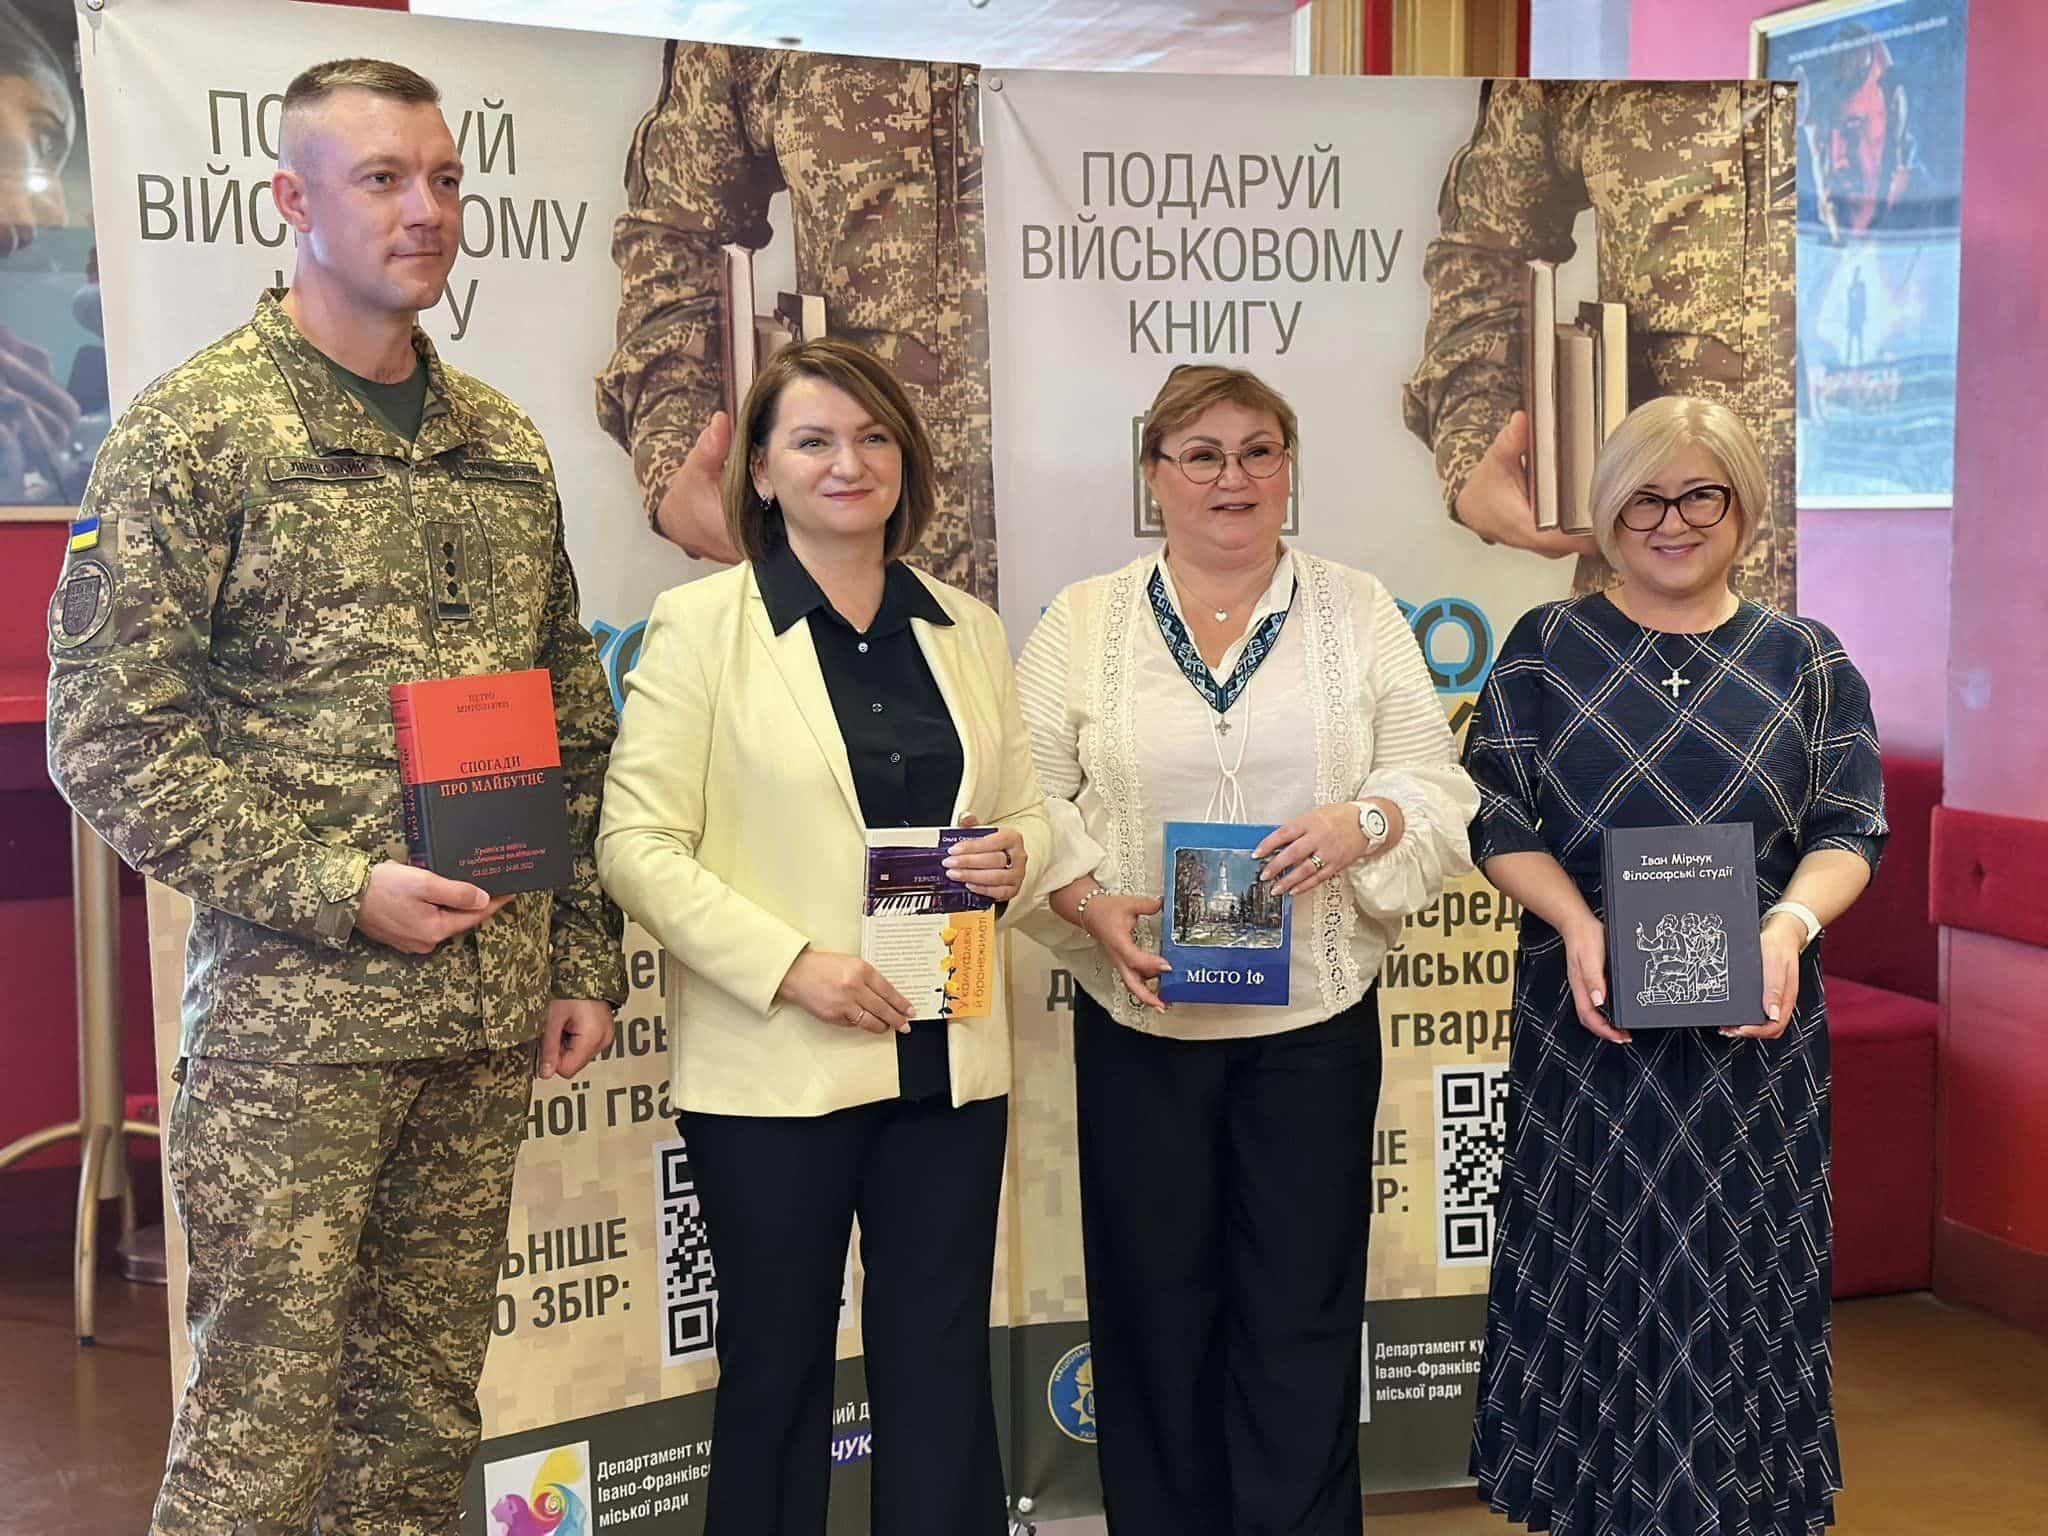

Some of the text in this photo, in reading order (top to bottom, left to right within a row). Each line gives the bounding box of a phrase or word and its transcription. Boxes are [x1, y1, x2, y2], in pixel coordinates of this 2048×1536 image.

[1080, 143, 1341, 219] ПОДАРУЙ
[1021, 213, 1403, 283] ВІЙСЬКОВОМУ
[1129, 299, 1302, 355] КНИГУ
[460, 755, 521, 774] СПОГАДИ
[440, 771, 545, 797] ПРО МАЙБУТНЄ
[1640, 853, 1713, 866] Іван Мірчук
[1622, 866, 1734, 882] Філософські студії
[1186, 968, 1265, 985] МІСТО ІФ
[532, 1273, 631, 1329] ЗБІР:
[1375, 1340, 1465, 1360] Департамент
[1375, 1360, 1481, 1380] Івано-Франківс
[1376, 1382, 1462, 1401] міської ради
[597, 1443, 693, 1482] Департамент
[599, 1492, 690, 1528] міської ради
